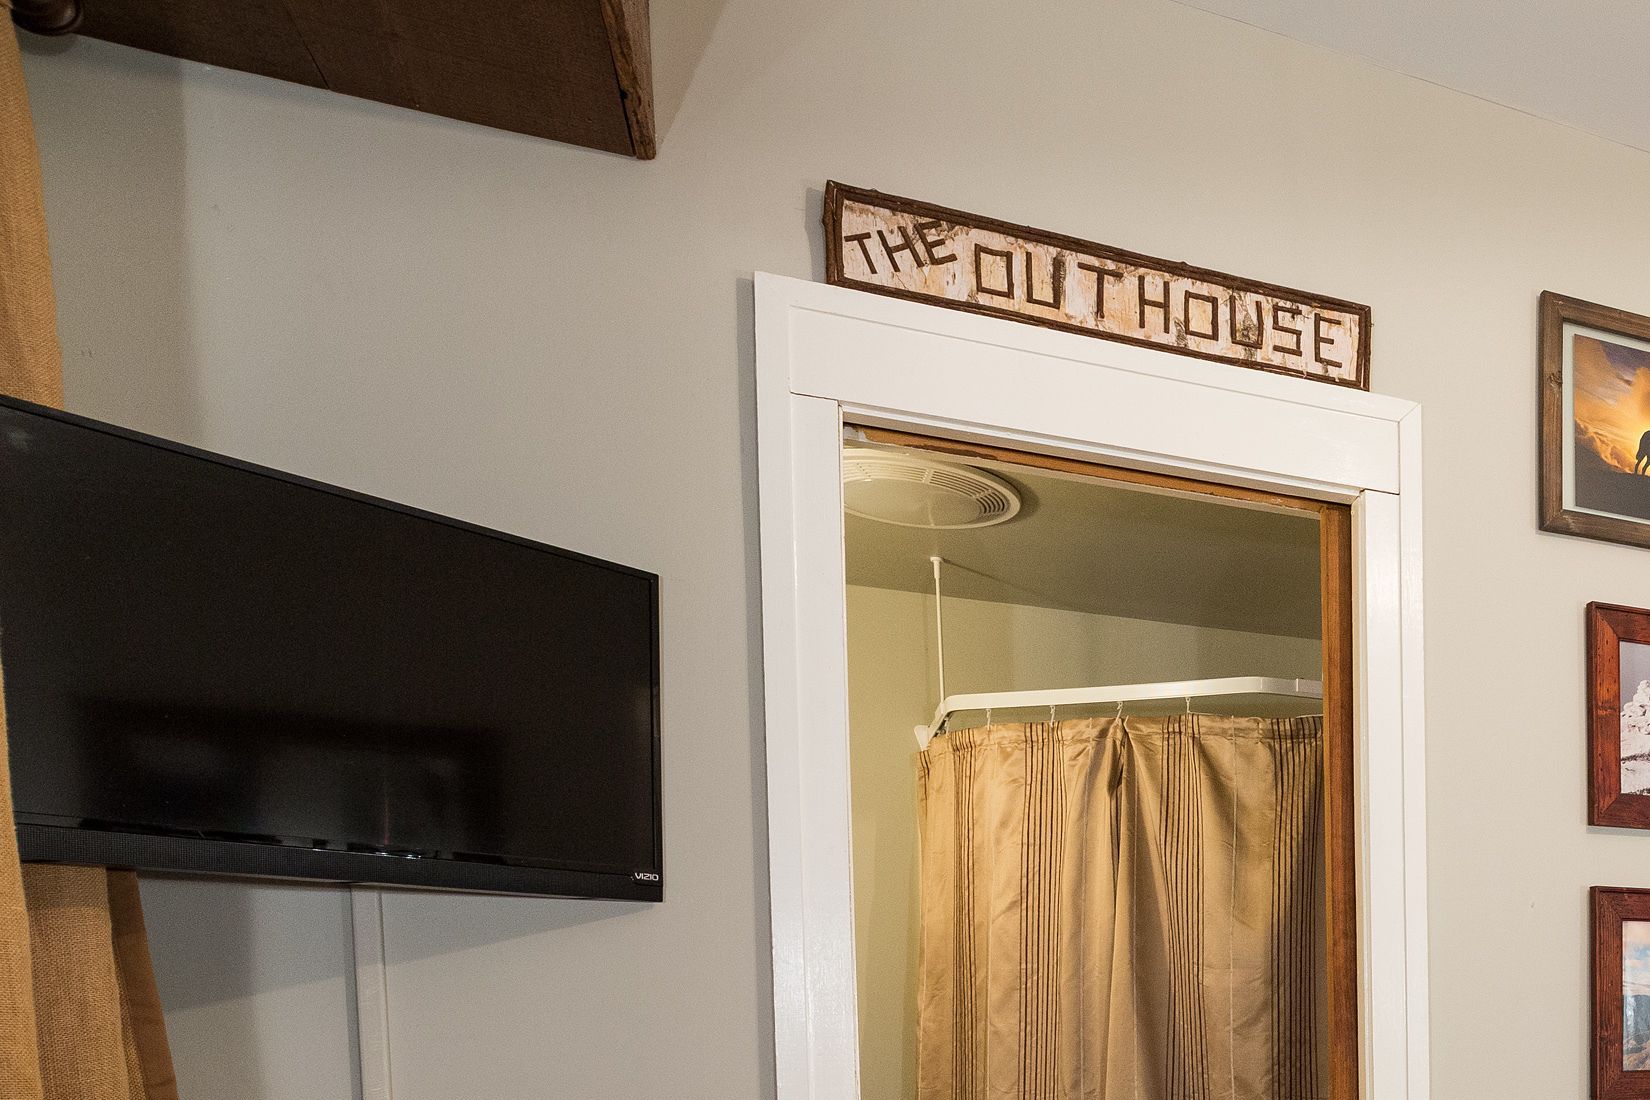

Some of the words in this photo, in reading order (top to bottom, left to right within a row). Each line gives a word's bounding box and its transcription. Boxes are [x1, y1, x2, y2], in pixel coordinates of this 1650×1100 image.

[843, 220, 958, 275] THE
[974, 243, 1344, 370] OUTHOUSE
[634, 872, 660, 881] VIZIO
